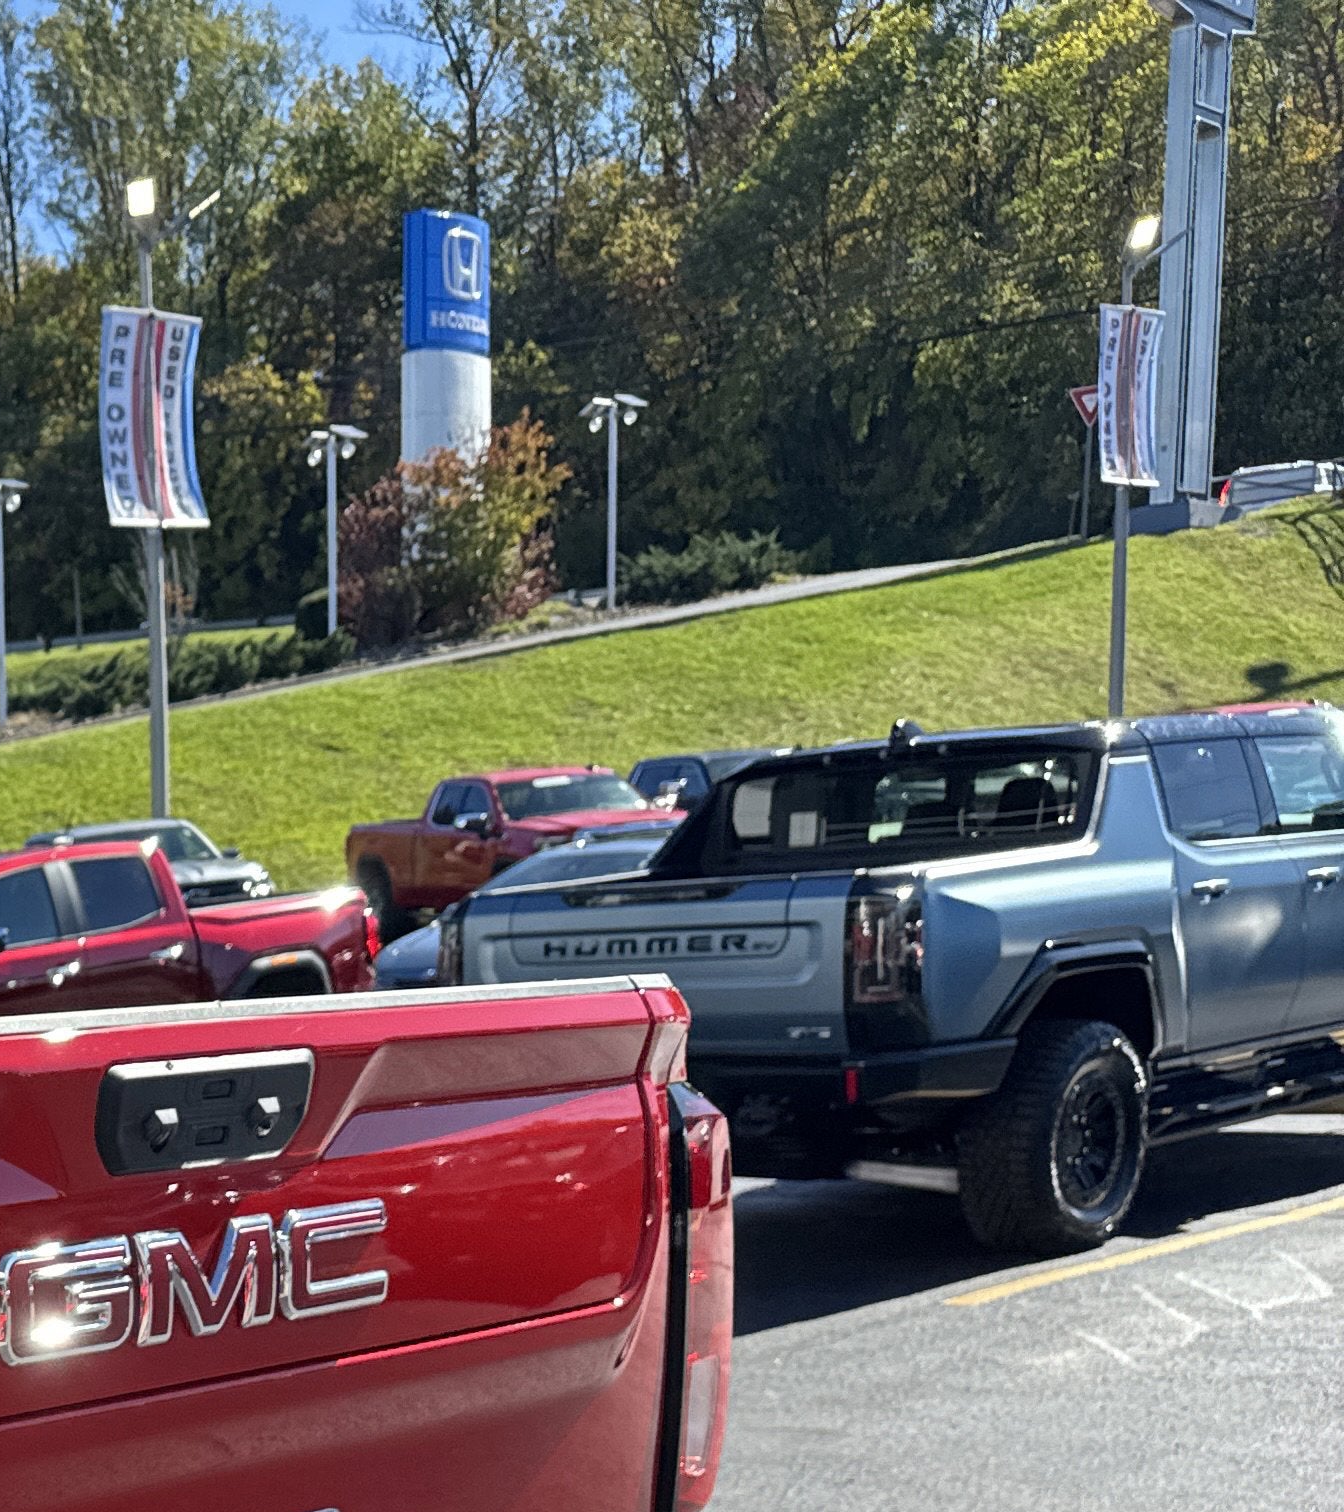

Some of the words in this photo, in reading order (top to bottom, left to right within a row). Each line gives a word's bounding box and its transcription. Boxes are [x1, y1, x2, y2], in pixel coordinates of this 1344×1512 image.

[430, 310, 489, 336] HONDA
[109, 325, 131, 389] PRE
[164, 326, 184, 400] USED
[107, 403, 136, 512] OWNED
[544, 934, 748, 958] HUMMER
